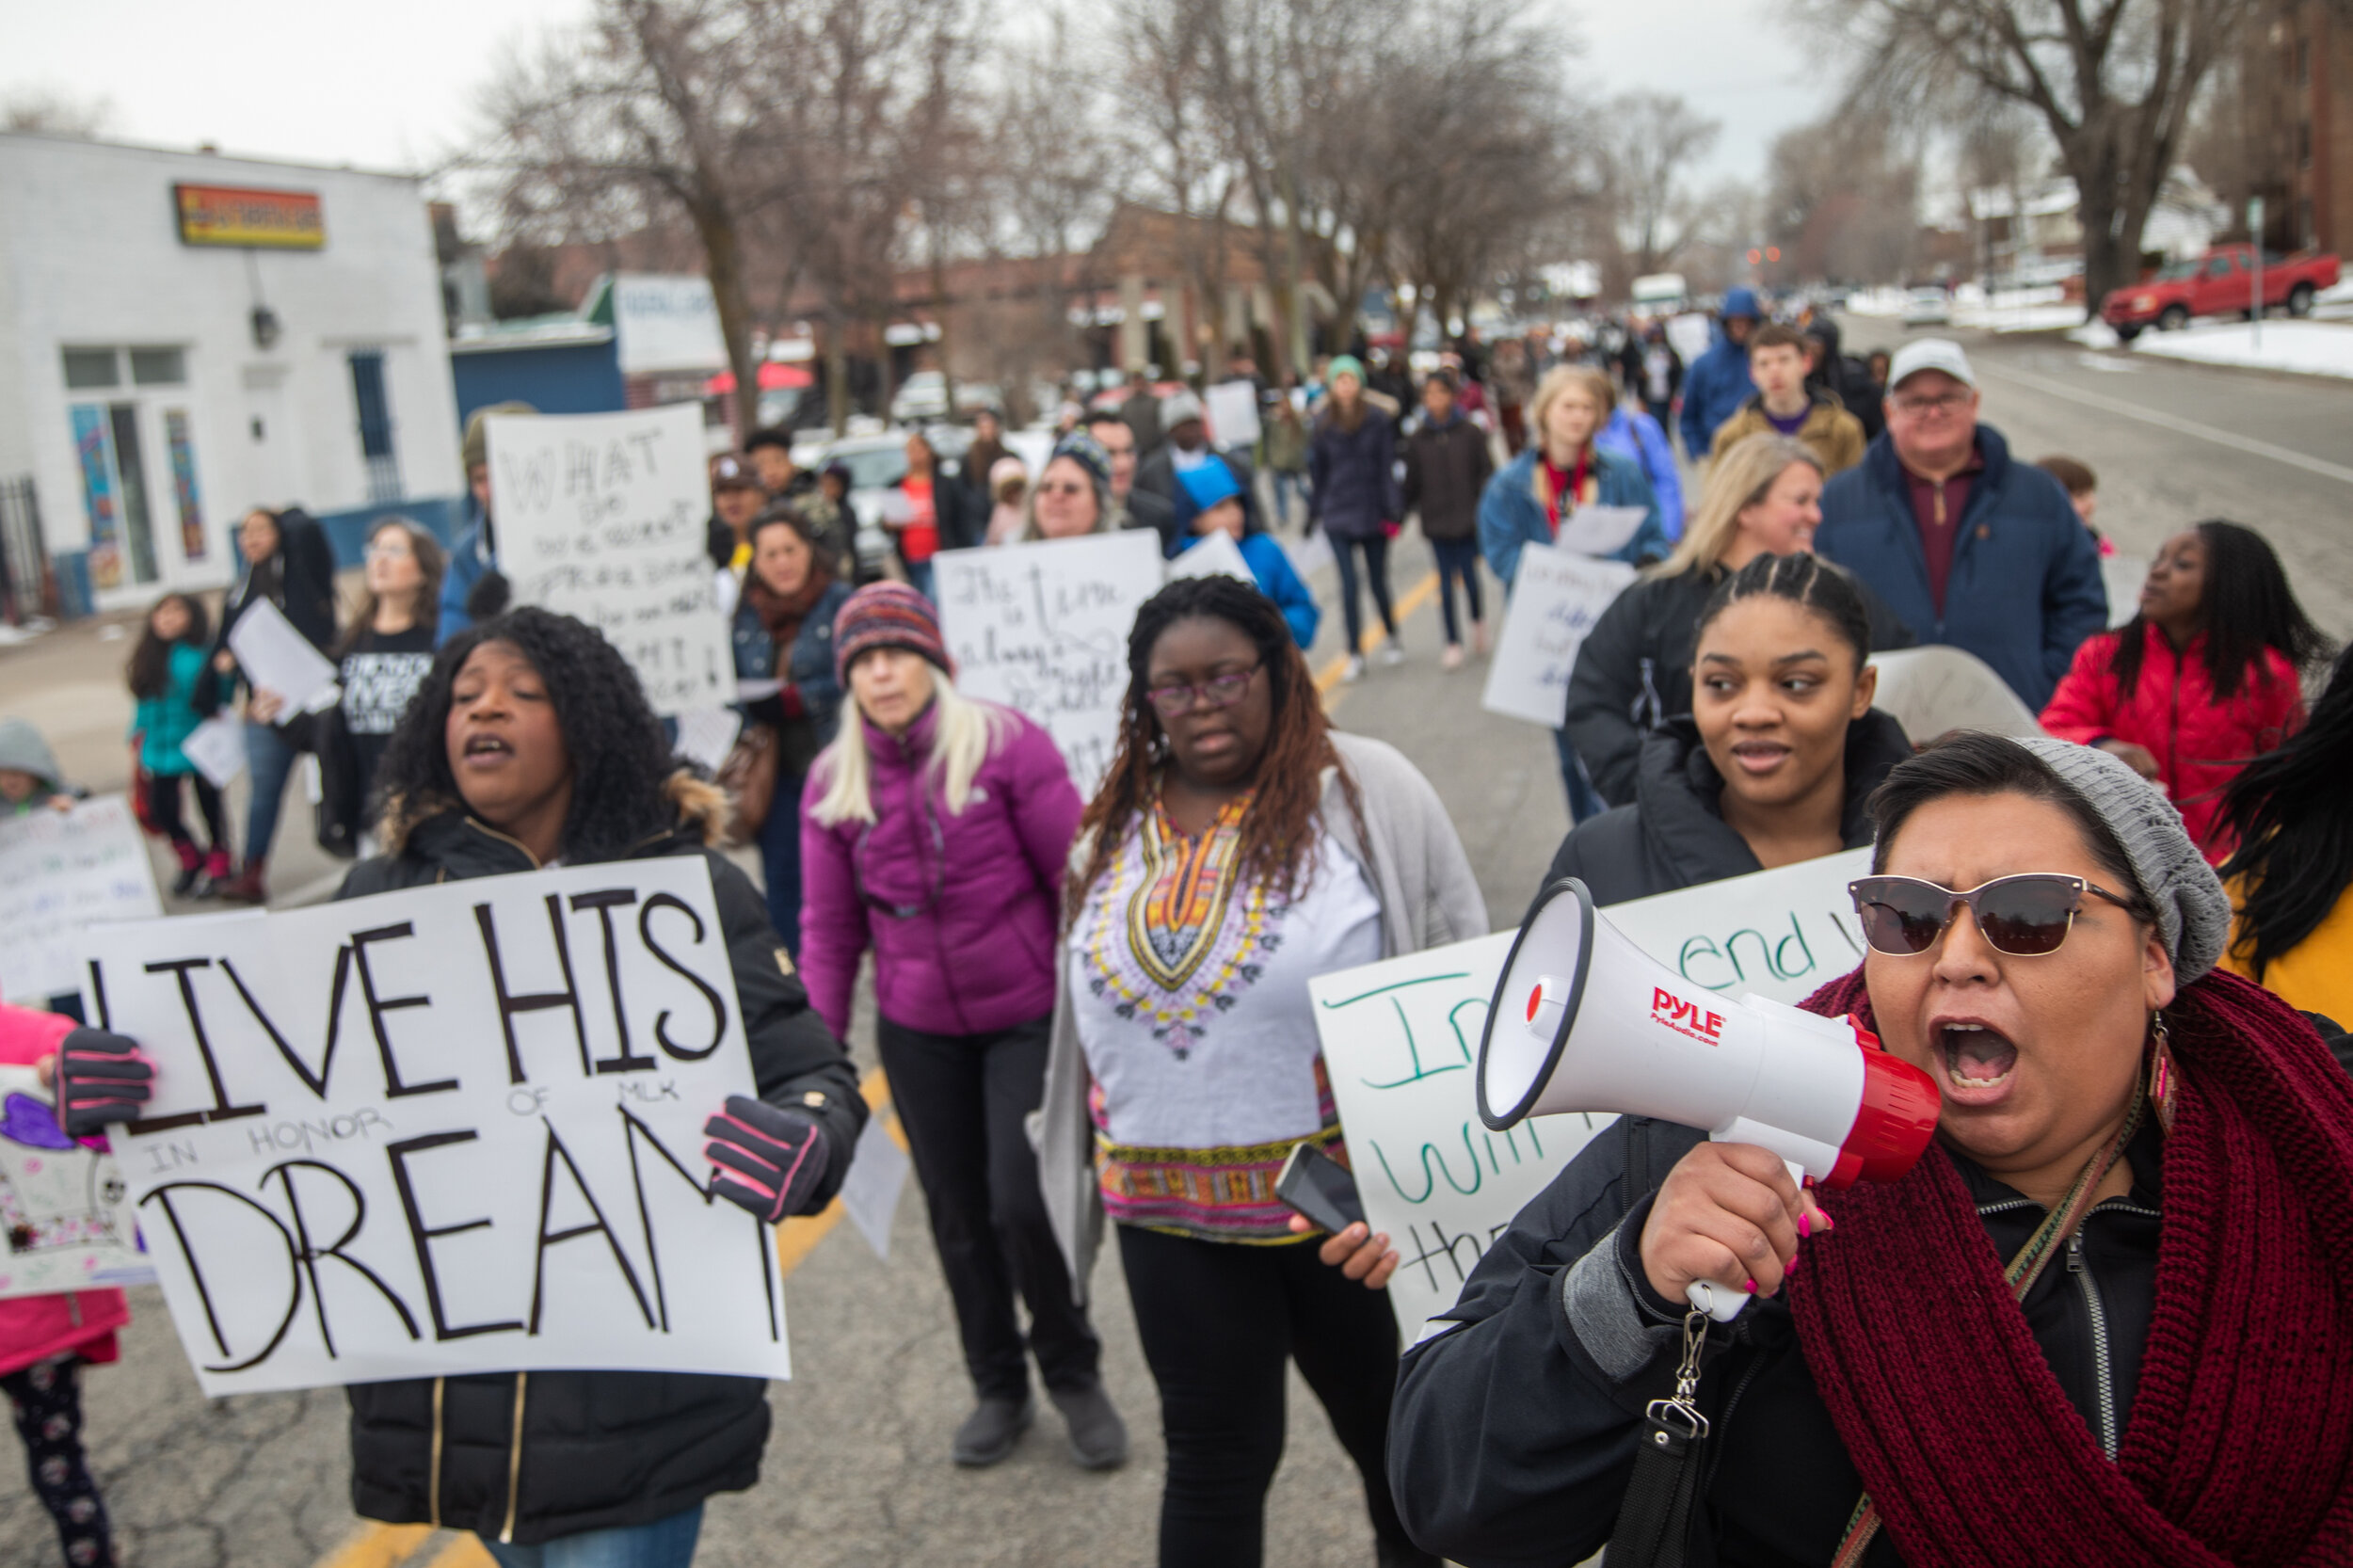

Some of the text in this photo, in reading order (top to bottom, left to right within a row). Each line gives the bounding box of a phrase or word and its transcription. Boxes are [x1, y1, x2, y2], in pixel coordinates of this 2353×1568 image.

[499, 427, 663, 513] WHAT
[1680, 909, 1817, 990] end
[88, 888, 728, 1135] LIVE HIS
[1650, 1012, 1720, 1048] PyleAudio.com
[143, 1079, 681, 1174] IN HONOR OF MLK
[138, 1102, 780, 1372] DREAM
